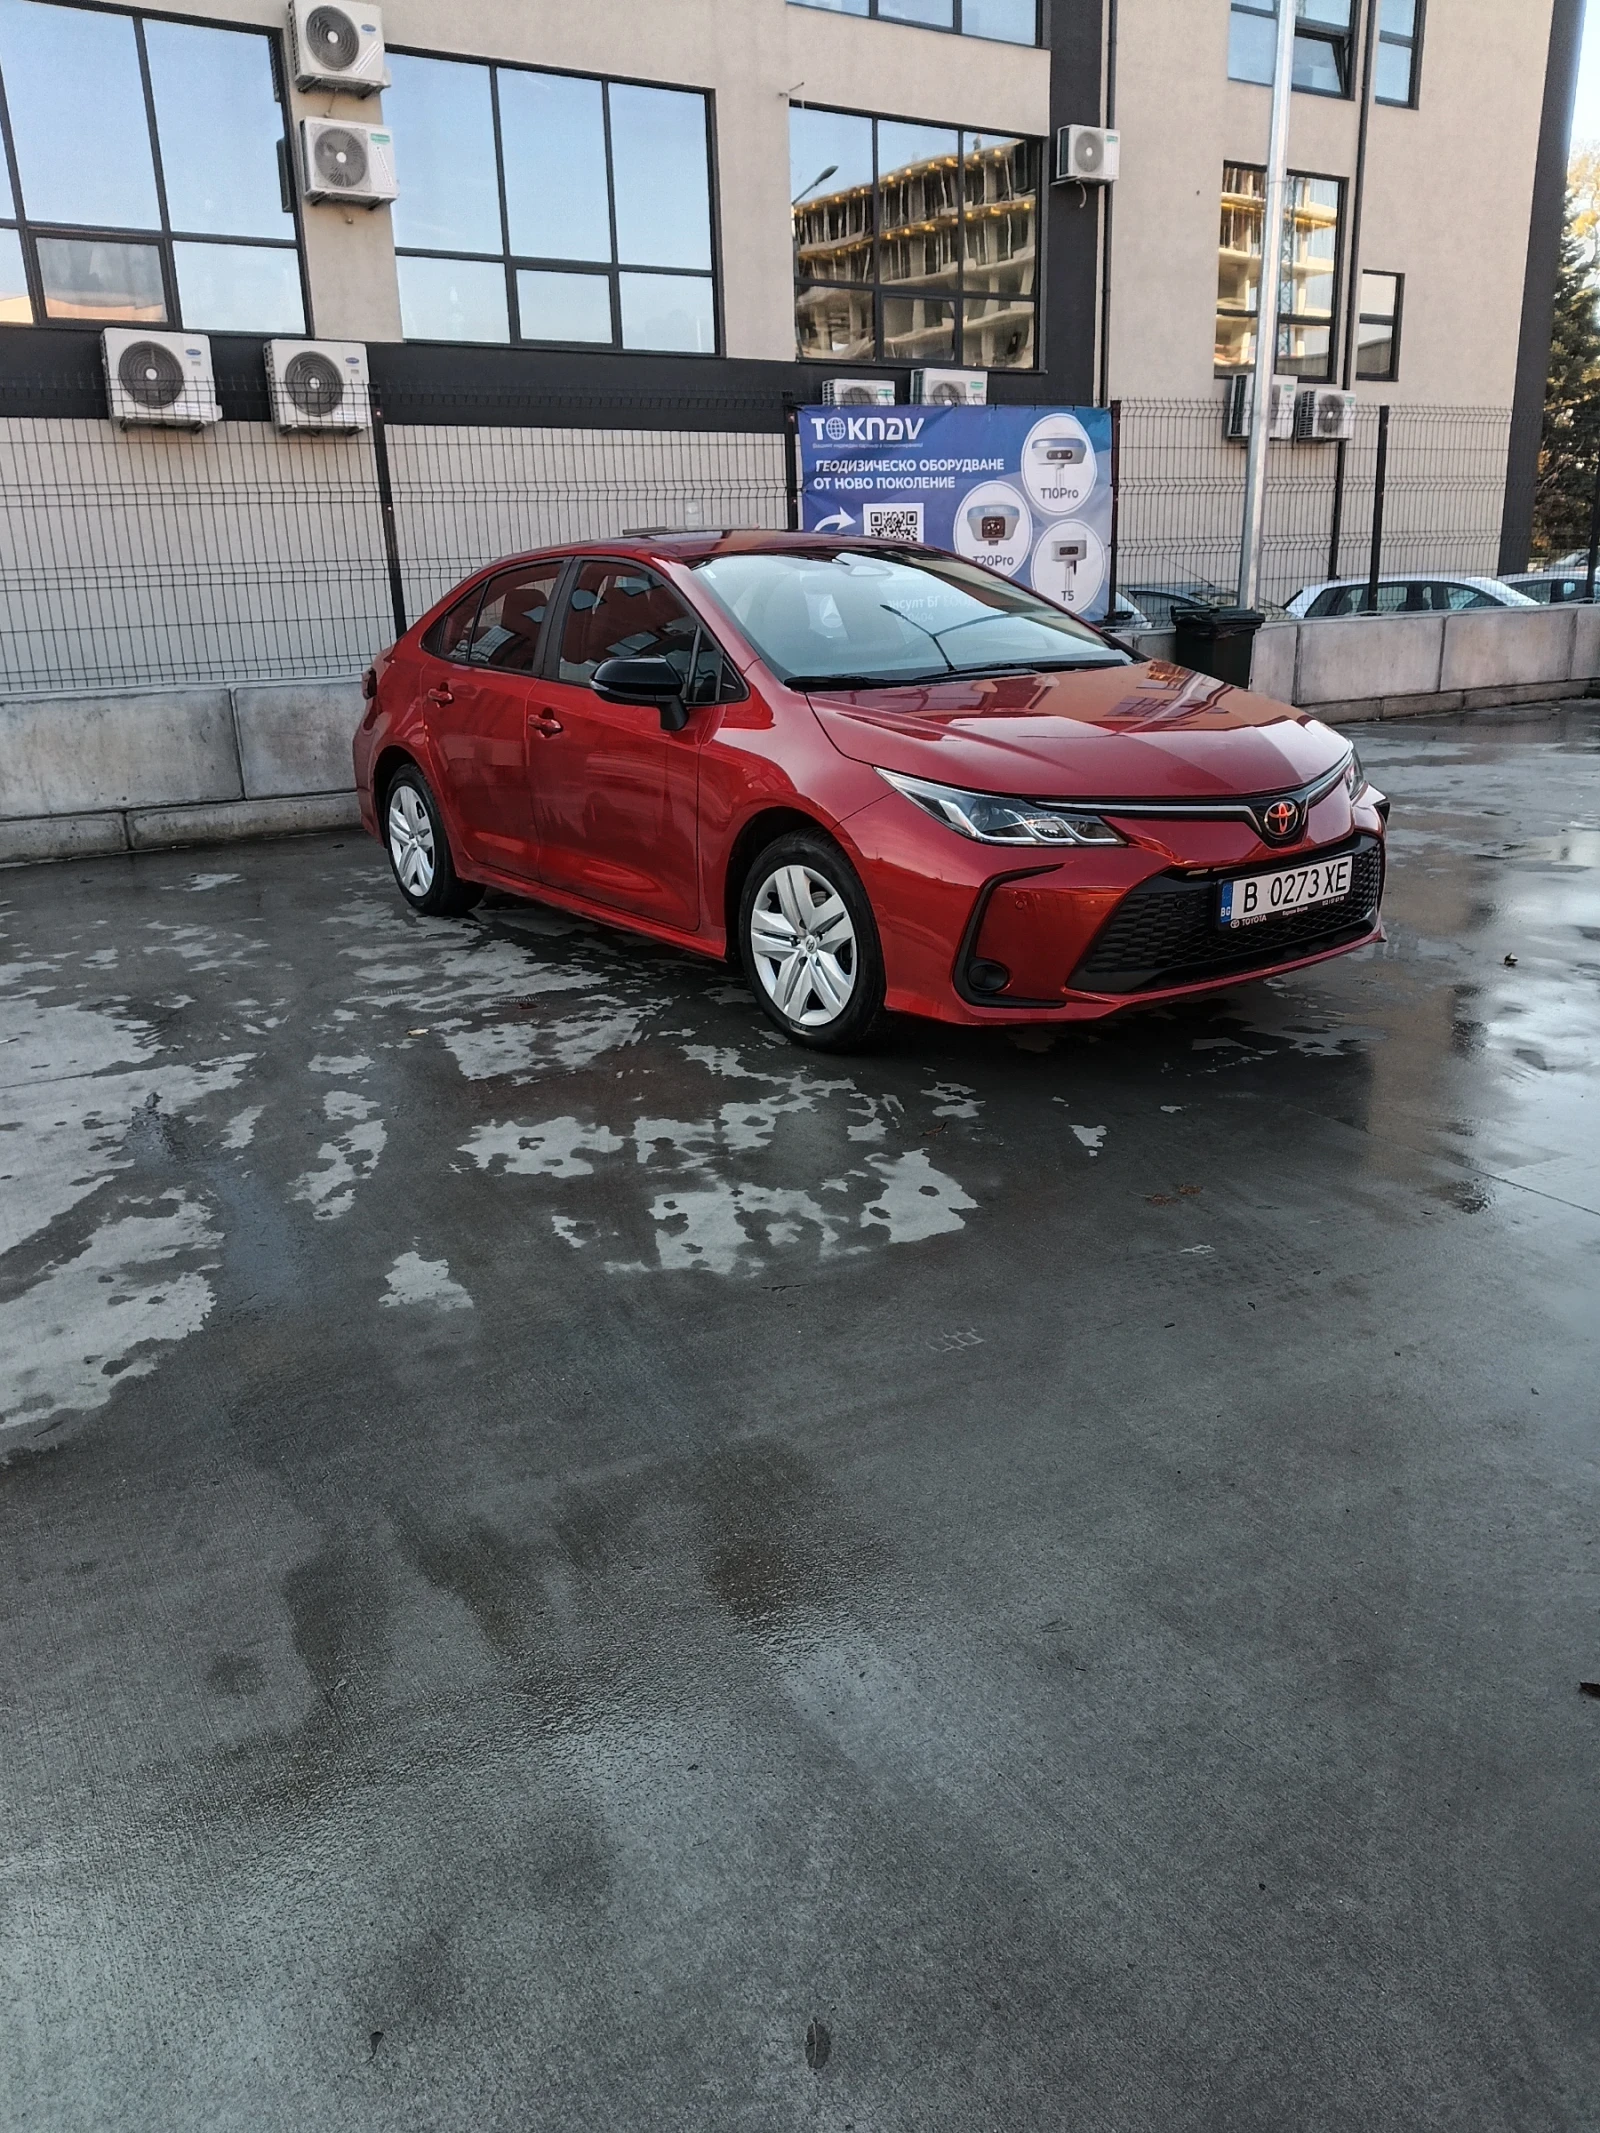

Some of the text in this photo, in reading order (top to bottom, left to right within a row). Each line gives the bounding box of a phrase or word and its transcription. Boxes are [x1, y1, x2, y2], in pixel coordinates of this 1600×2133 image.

[811, 416, 925, 441] TOKNAV
[815, 458, 1005, 474] ГЕОДИЗИЧЕСКО ОБОРУДВАНЕ
[813, 476, 956, 490] ОТ НОВО ПОКОЛЕНИЕ
[1040, 487, 1079, 499] T10Pro
[1061, 590, 1075, 601] T5
[1243, 861, 1349, 914] B 0273 XE
[1220, 906, 1231, 917] BG
[1241, 914, 1267, 927] TOYOTA
